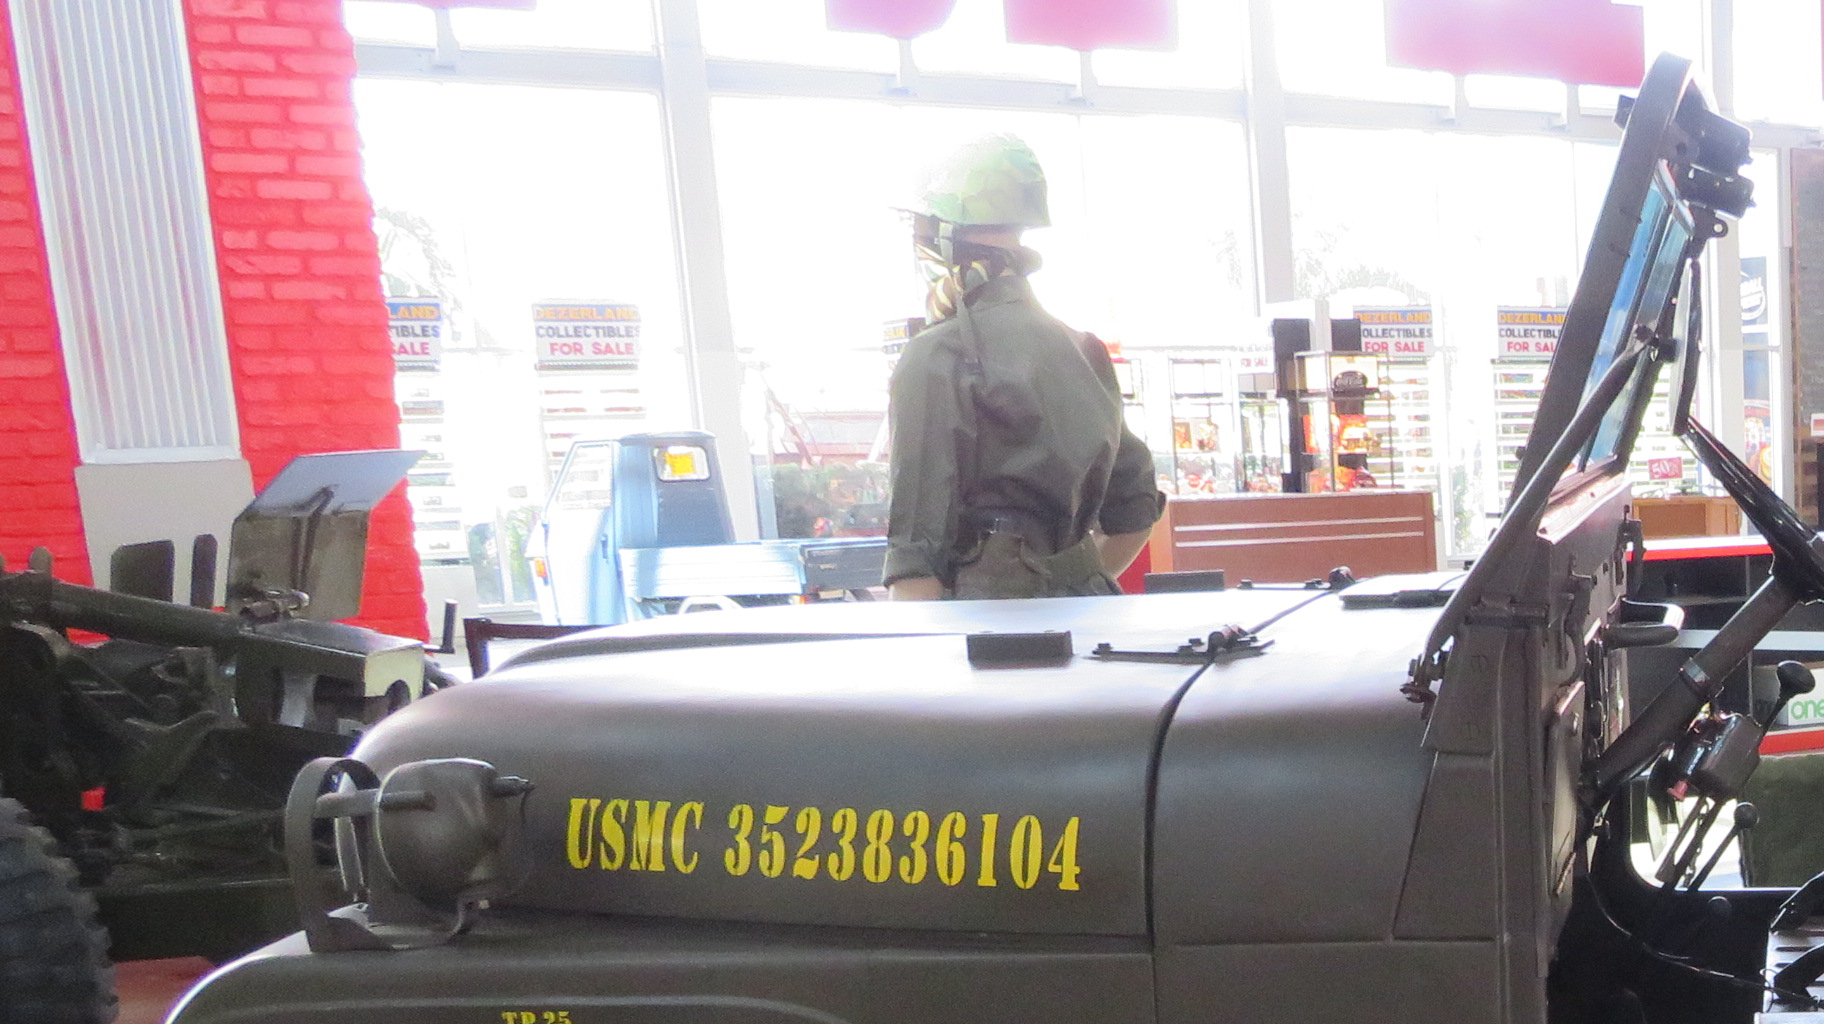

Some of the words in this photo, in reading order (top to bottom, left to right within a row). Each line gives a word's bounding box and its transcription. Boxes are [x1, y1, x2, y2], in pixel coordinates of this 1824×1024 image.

[1499, 312, 1566, 324] DEZERLAN
[535, 325, 640, 338] COLLECTIBLES
[1362, 328, 1433, 338] OLLECTIBLES
[1498, 328, 1561, 338] COLLECTIBL
[394, 341, 431, 355] ALE
[549, 342, 584, 355] FOR
[592, 341, 634, 355] SALE
[1364, 341, 1389, 352] FOR
[1394, 341, 1425, 352] SALE
[1506, 341, 1529, 352] FOR
[1535, 342, 1557, 352] SAL
[567, 798, 704, 874] USMC
[724, 803, 1081, 890] 3523836104
